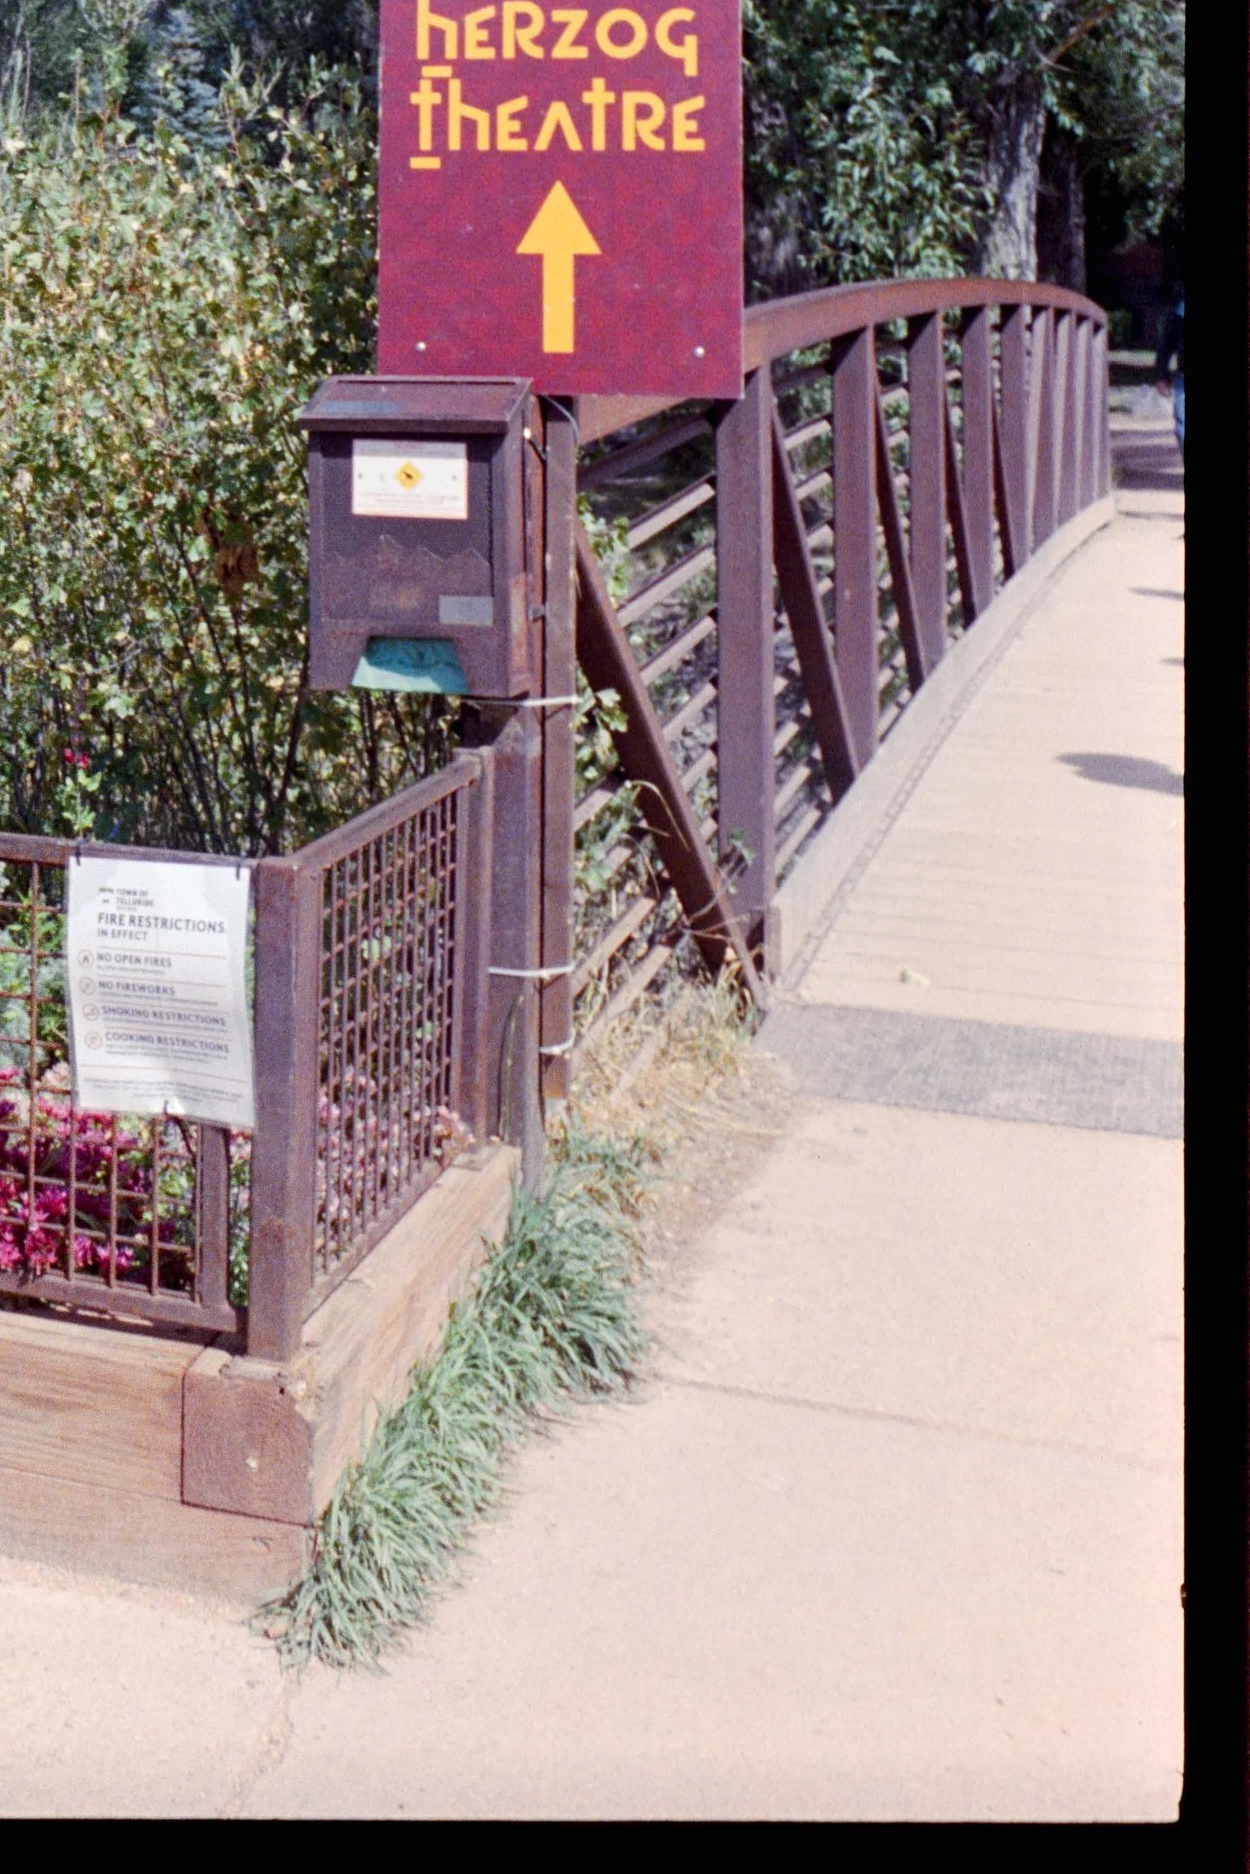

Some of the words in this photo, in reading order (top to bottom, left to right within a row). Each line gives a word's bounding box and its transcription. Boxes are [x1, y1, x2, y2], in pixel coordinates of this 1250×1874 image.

[116, 888, 137, 897] TOWN
[97, 912, 126, 926] FIRE
[129, 915, 225, 934] RESTRICTIONS
[97, 928, 108, 937] IN
[111, 929, 148, 941] EFFECT
[96, 953, 112, 962] NO
[114, 953, 142, 965] OPEN
[144, 956, 172, 968] FIRES
[98, 981, 113, 990] NO
[116, 982, 176, 996] FIREWORKS
[102, 1006, 150, 1018] SMOKING
[152, 1010, 227, 1027] RESTRICTIONS
[105, 1032, 155, 1044] COOKING
[157, 1036, 230, 1053] RESTRICTIONS
